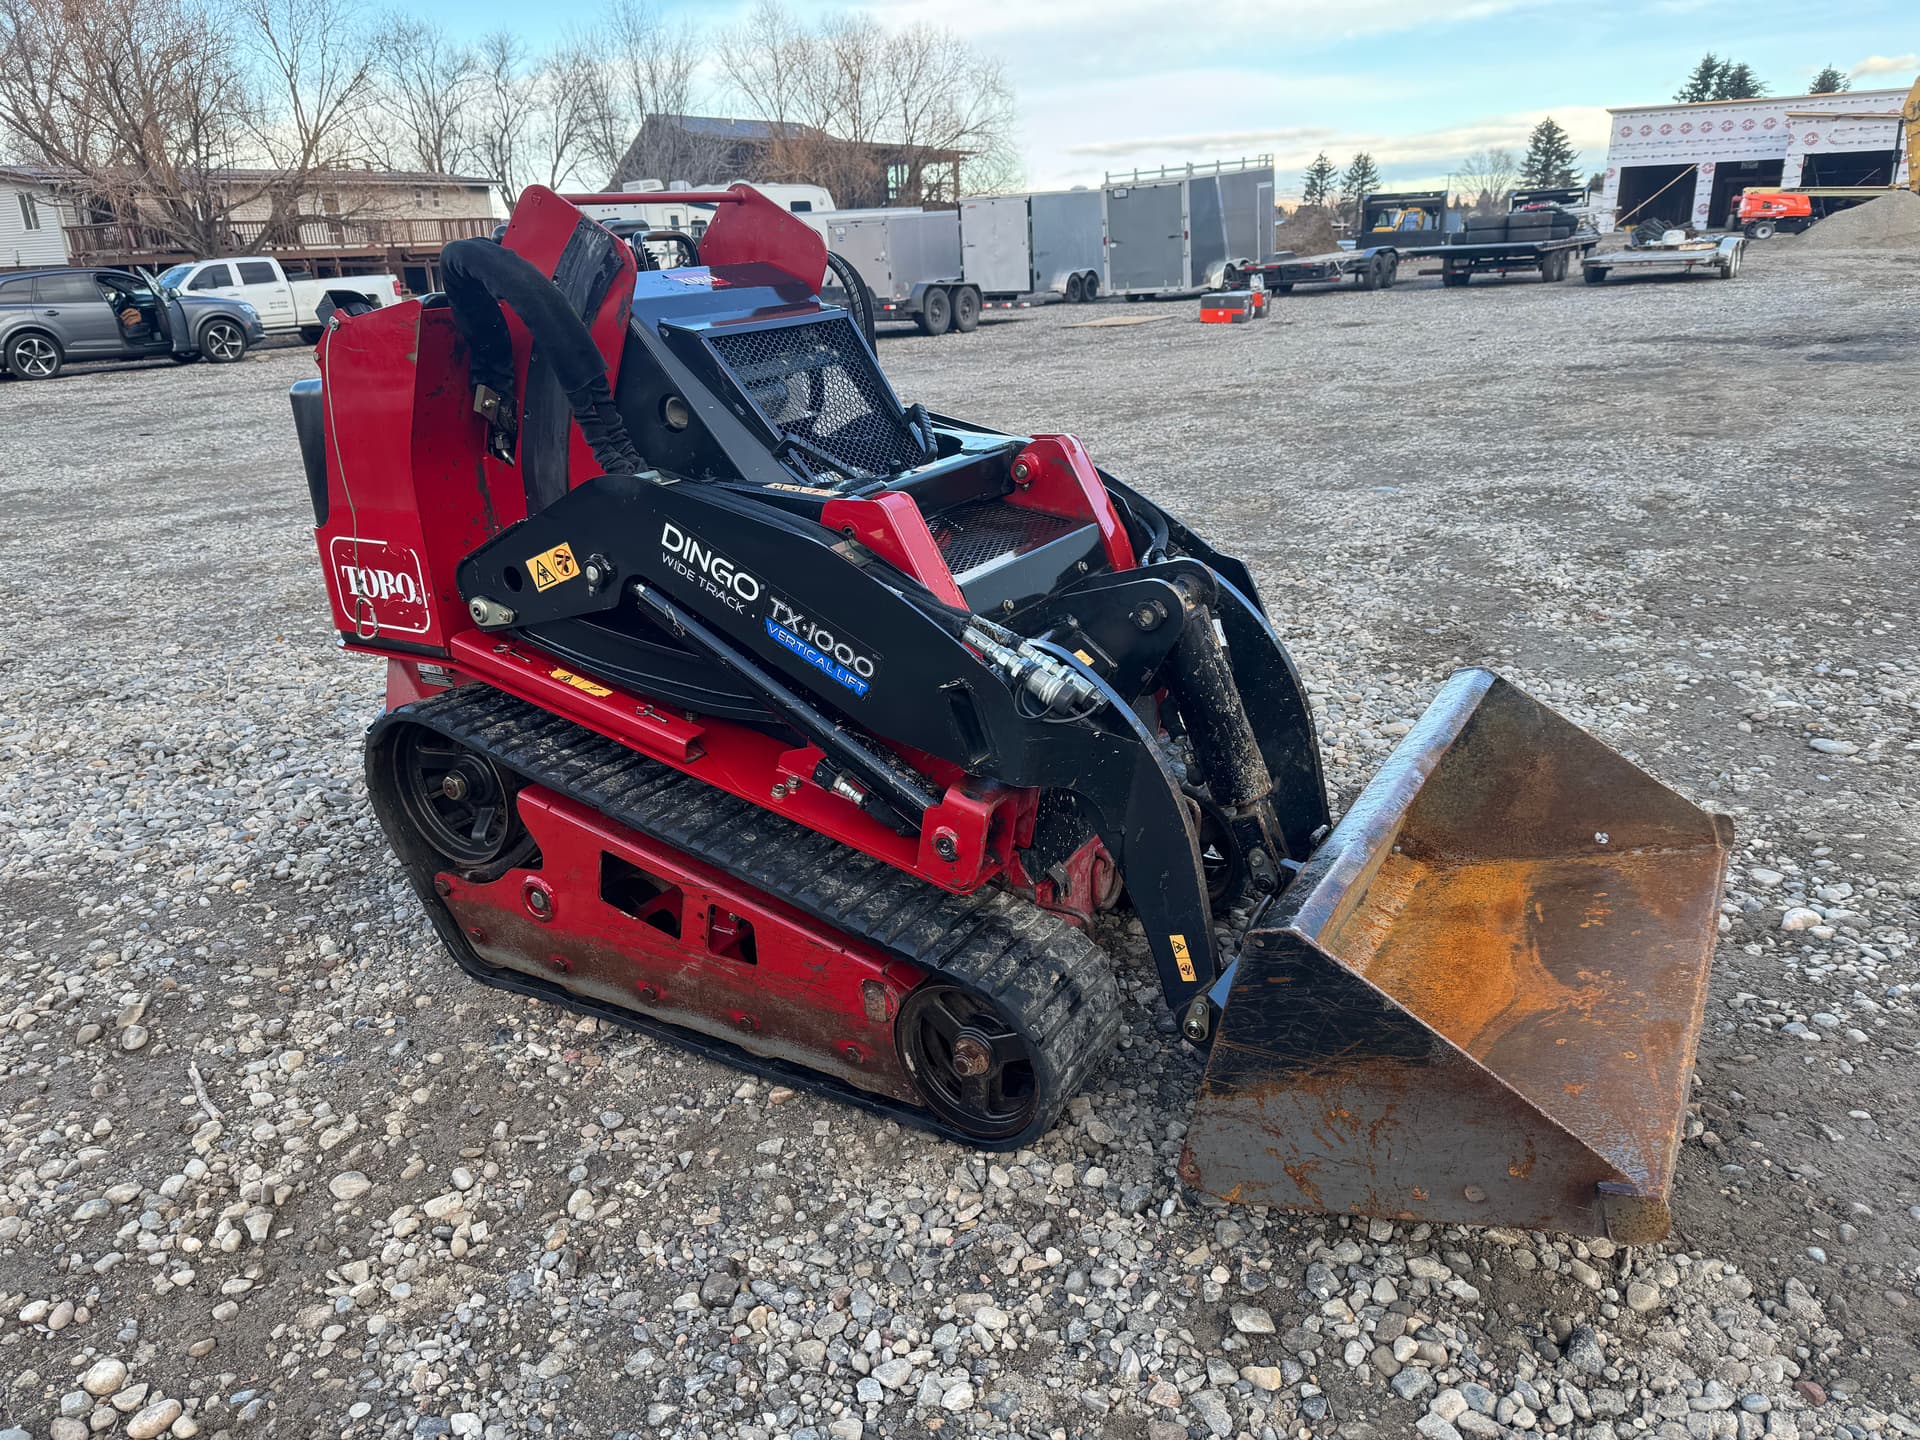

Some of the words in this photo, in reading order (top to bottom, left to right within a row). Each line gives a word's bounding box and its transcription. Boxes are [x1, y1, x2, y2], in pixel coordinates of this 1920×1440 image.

[340, 565, 417, 604] TORO
[660, 522, 760, 602] DINGO
[662, 551, 696, 583] WIDE
[698, 575, 747, 615] TRACK
[769, 622, 833, 675] VERTICAL
[836, 668, 866, 693] LIFT
